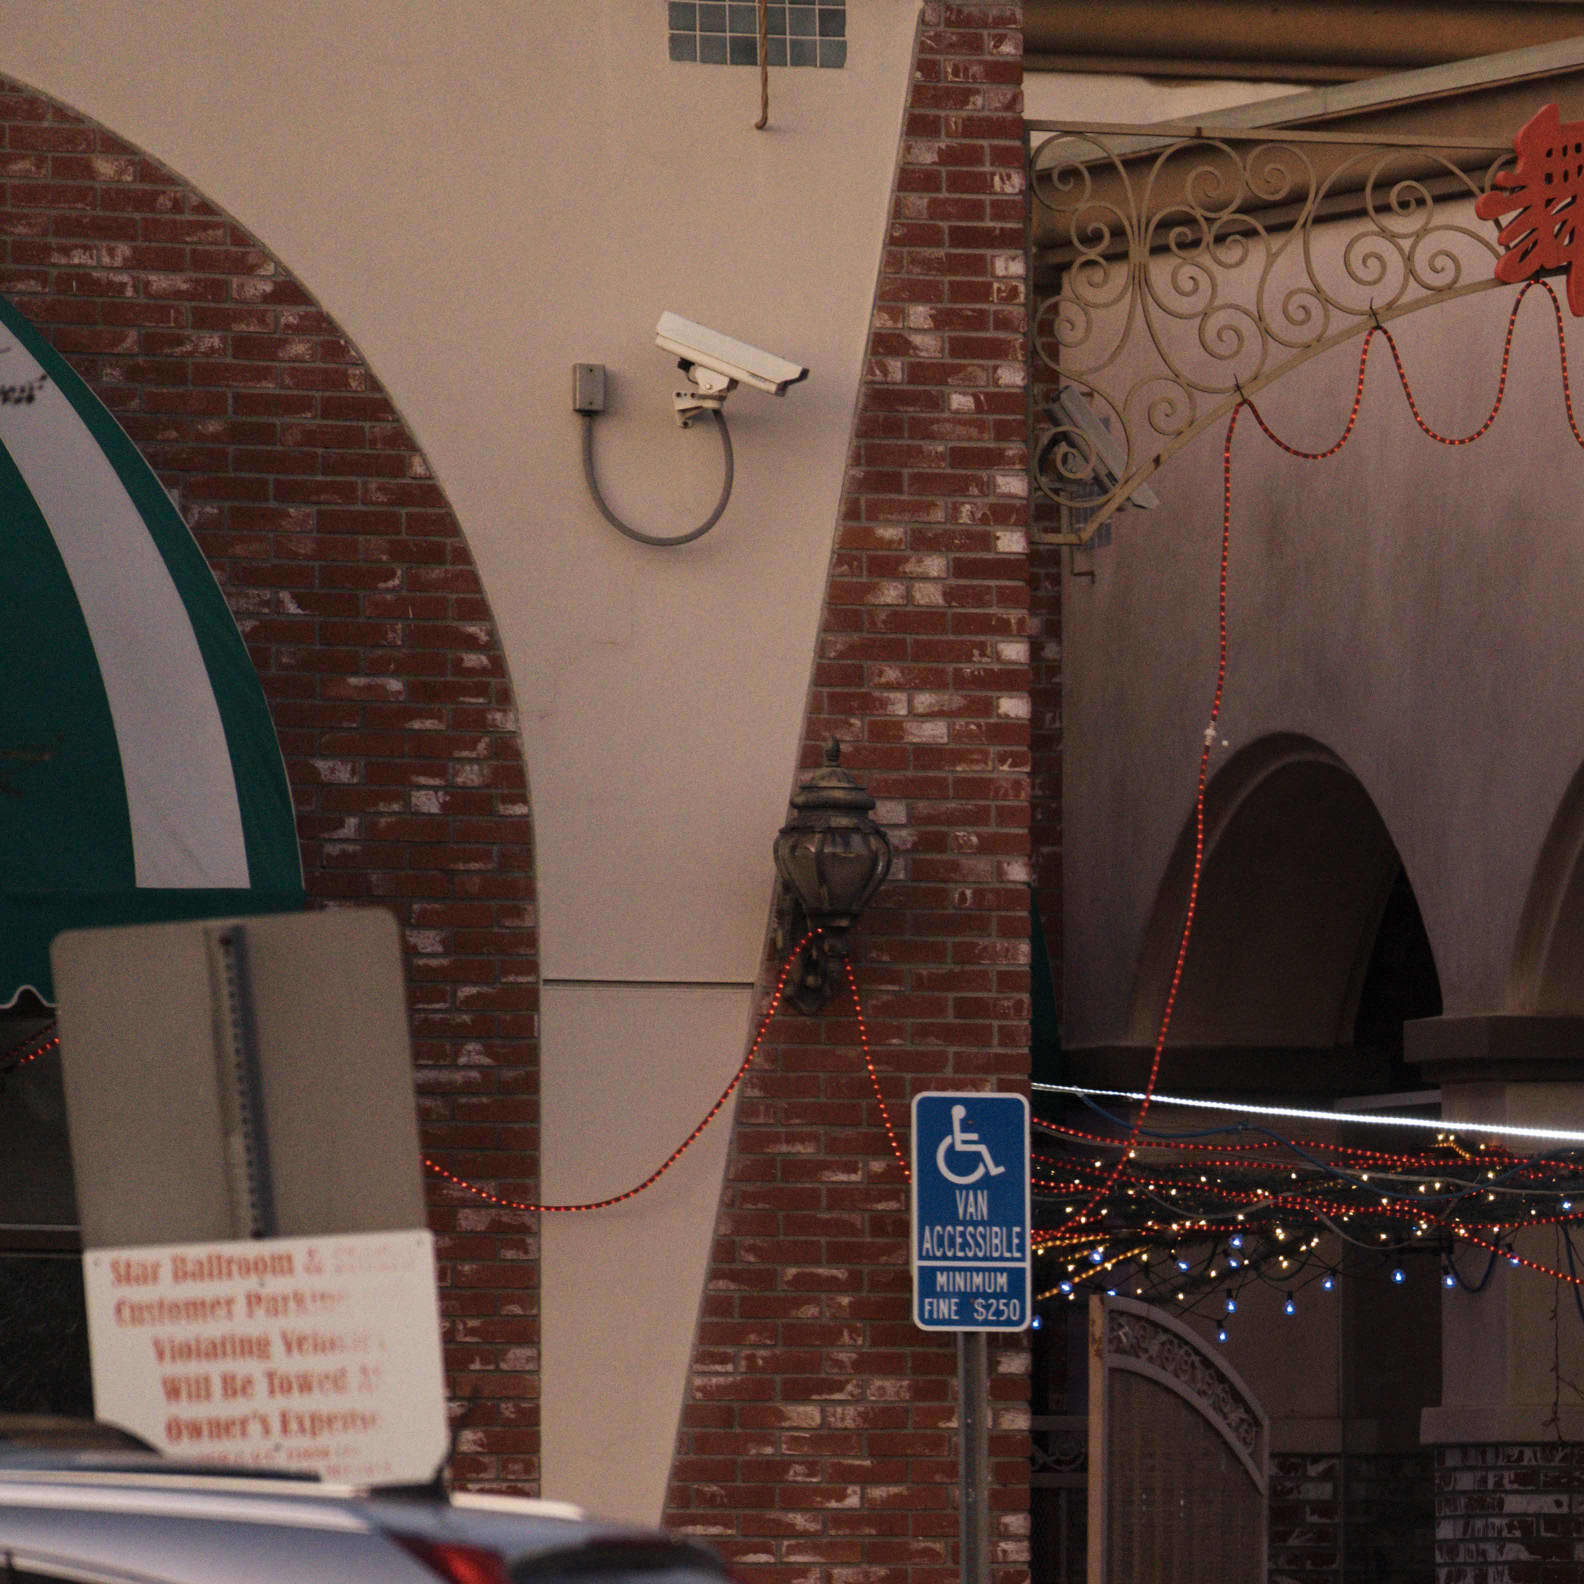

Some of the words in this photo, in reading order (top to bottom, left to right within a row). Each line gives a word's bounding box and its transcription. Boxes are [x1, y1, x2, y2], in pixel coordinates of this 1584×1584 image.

[955, 1190, 988, 1221] VAN
[922, 1225, 1022, 1258] ACCESSIBLE
[110, 1254, 162, 1287] Star
[171, 1250, 295, 1284] Ballroom
[936, 1271, 1008, 1294] MINIMUM
[114, 1293, 236, 1328] Customer
[924, 1298, 960, 1320] FINE
[973, 1297, 1020, 1322] $250
[152, 1332, 271, 1365] Violating
[161, 1373, 213, 1406] Will
[221, 1371, 255, 1401] Be
[265, 1366, 348, 1399] Towed
[165, 1411, 271, 1444] Owner's
